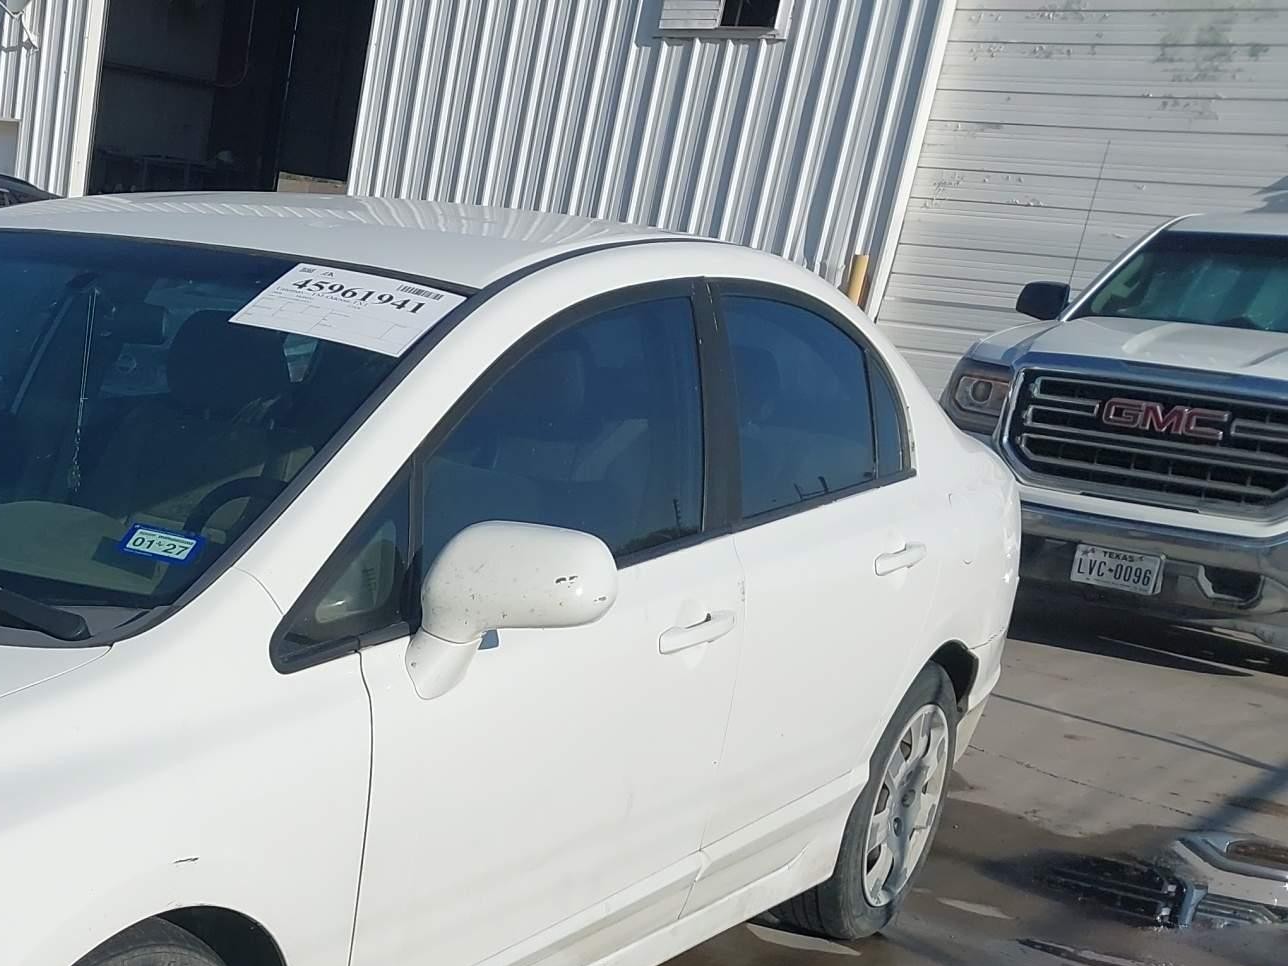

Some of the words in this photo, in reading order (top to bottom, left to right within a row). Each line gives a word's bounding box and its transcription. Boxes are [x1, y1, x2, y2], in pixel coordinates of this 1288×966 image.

[293, 278, 426, 313] 45961941
[1103, 398, 1231, 441] GMC
[132, 536, 155, 549] 01
[162, 543, 190, 556] 27
[1102, 550, 1135, 562] TEXAS
